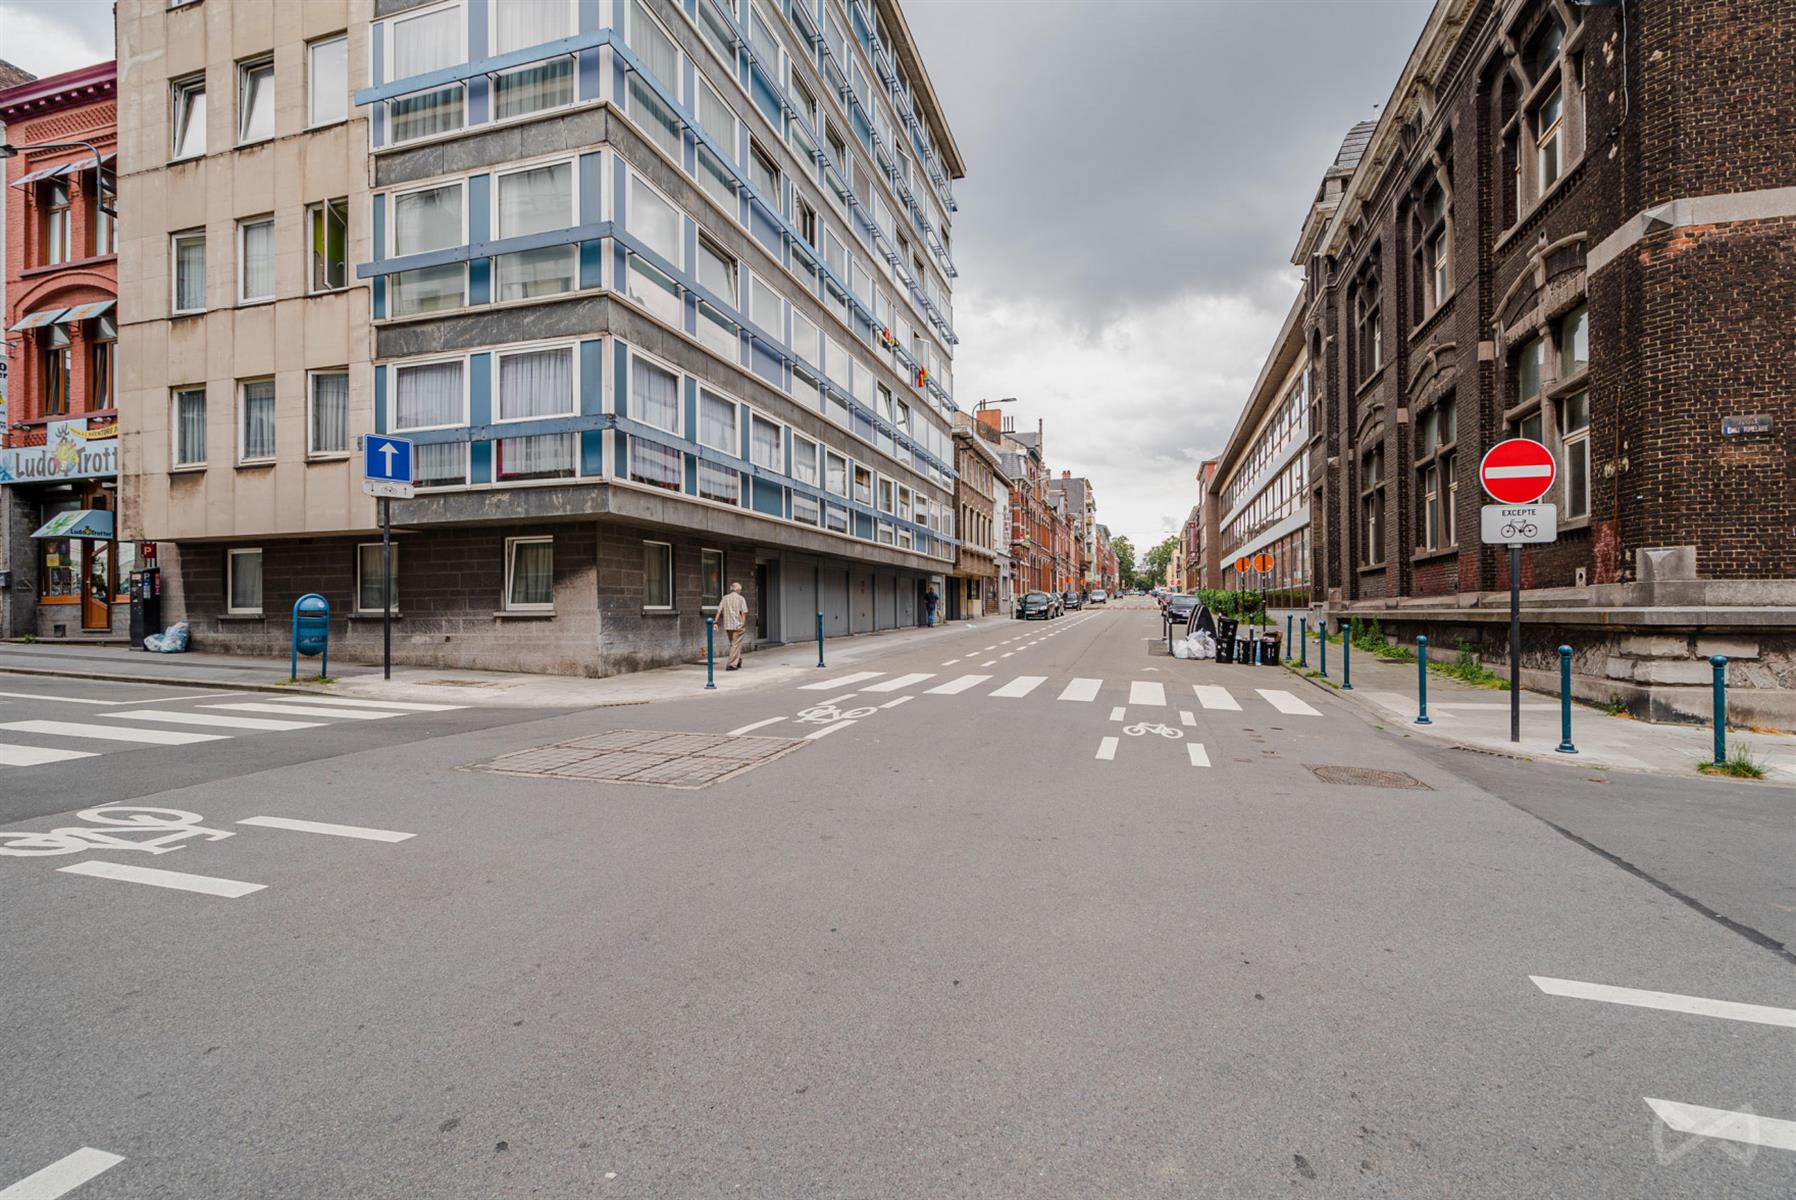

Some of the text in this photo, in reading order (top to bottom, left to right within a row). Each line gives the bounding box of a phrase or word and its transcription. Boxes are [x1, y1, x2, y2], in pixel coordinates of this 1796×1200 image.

[15, 446, 118, 478] Ludo Trott
[143, 546, 152, 556] P
